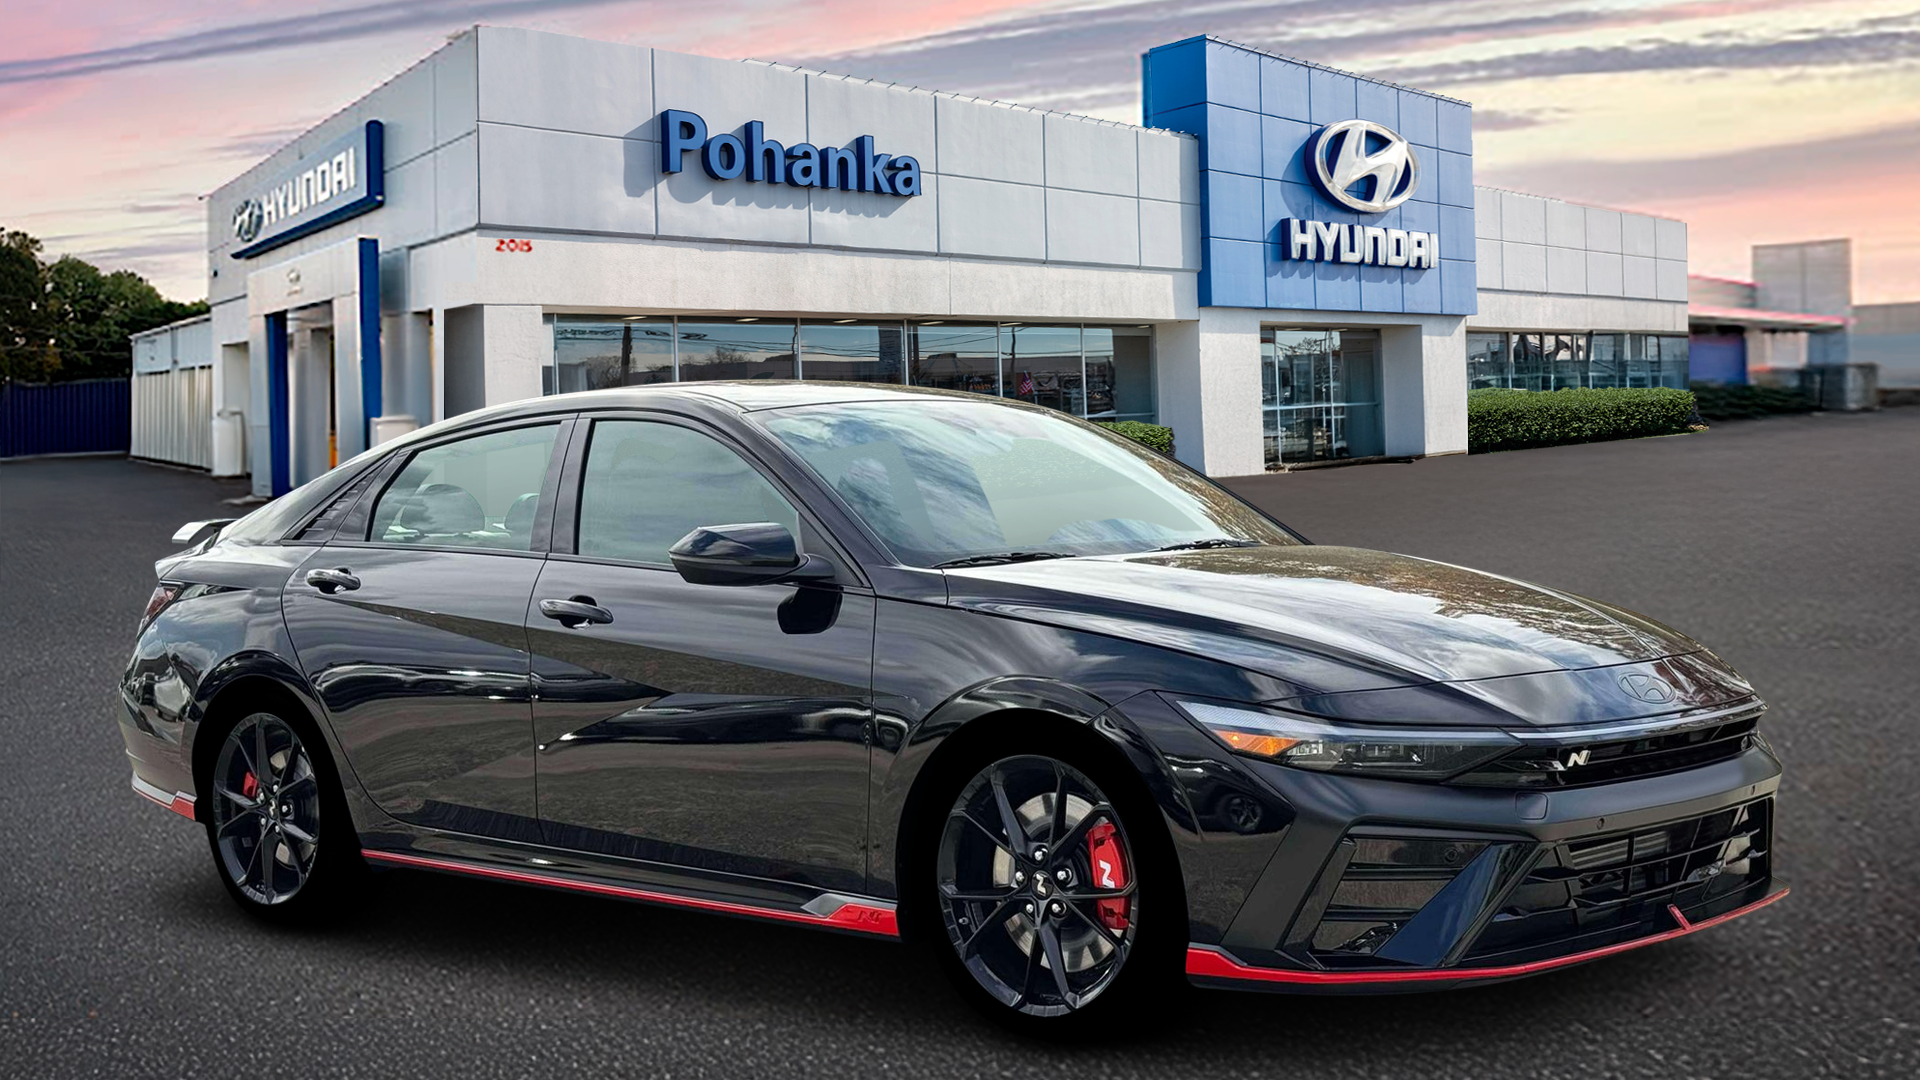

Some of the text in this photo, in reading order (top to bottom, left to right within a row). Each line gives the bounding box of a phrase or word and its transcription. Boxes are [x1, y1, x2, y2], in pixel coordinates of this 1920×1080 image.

[660, 108, 922, 196] Pohanka
[262, 146, 355, 226] HYUNDAI
[1282, 217, 1438, 269] HYUNDAI
[1567, 749, 1591, 767] N
[1099, 859, 1115, 888] N
